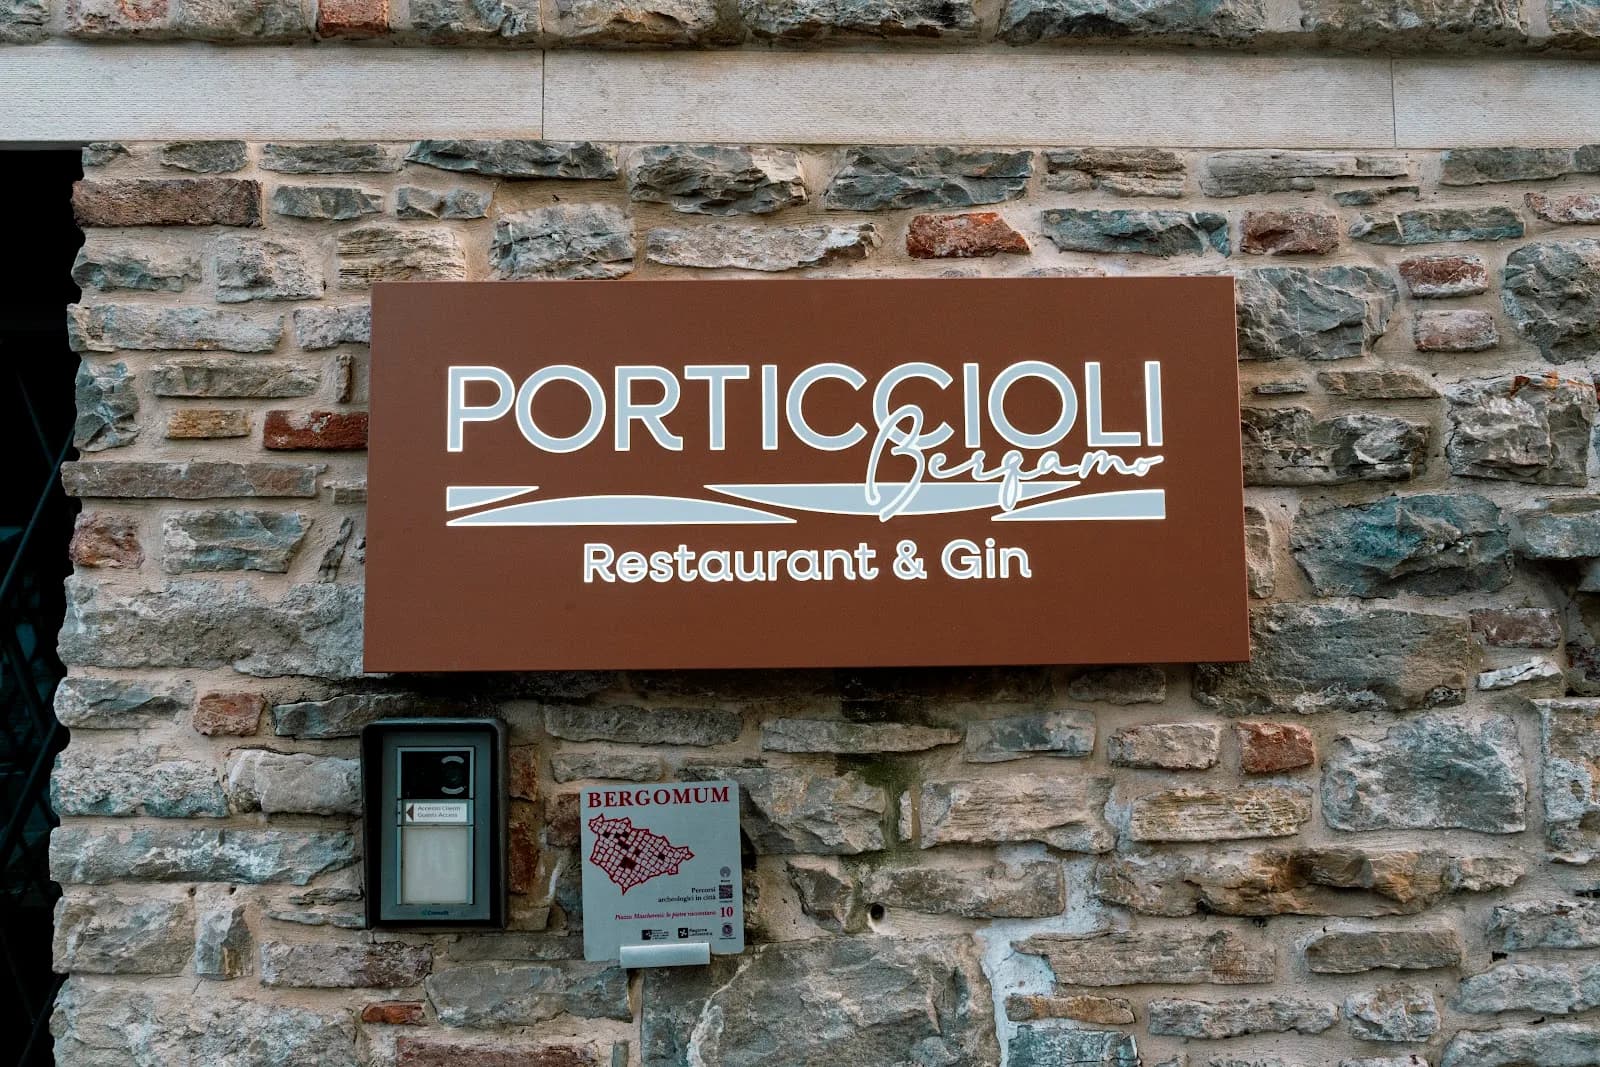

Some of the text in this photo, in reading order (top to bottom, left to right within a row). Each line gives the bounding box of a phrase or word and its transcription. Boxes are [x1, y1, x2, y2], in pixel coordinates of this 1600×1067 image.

[447, 361, 1164, 453] PORTICCIOLI
[864, 404, 1164, 521] Bergamo
[583, 538, 1032, 583] Restaurant & Gin
[588, 786, 730, 807] BERGOMUM
[657, 895, 695, 904] archeologici
[720, 906, 734, 918] 10
